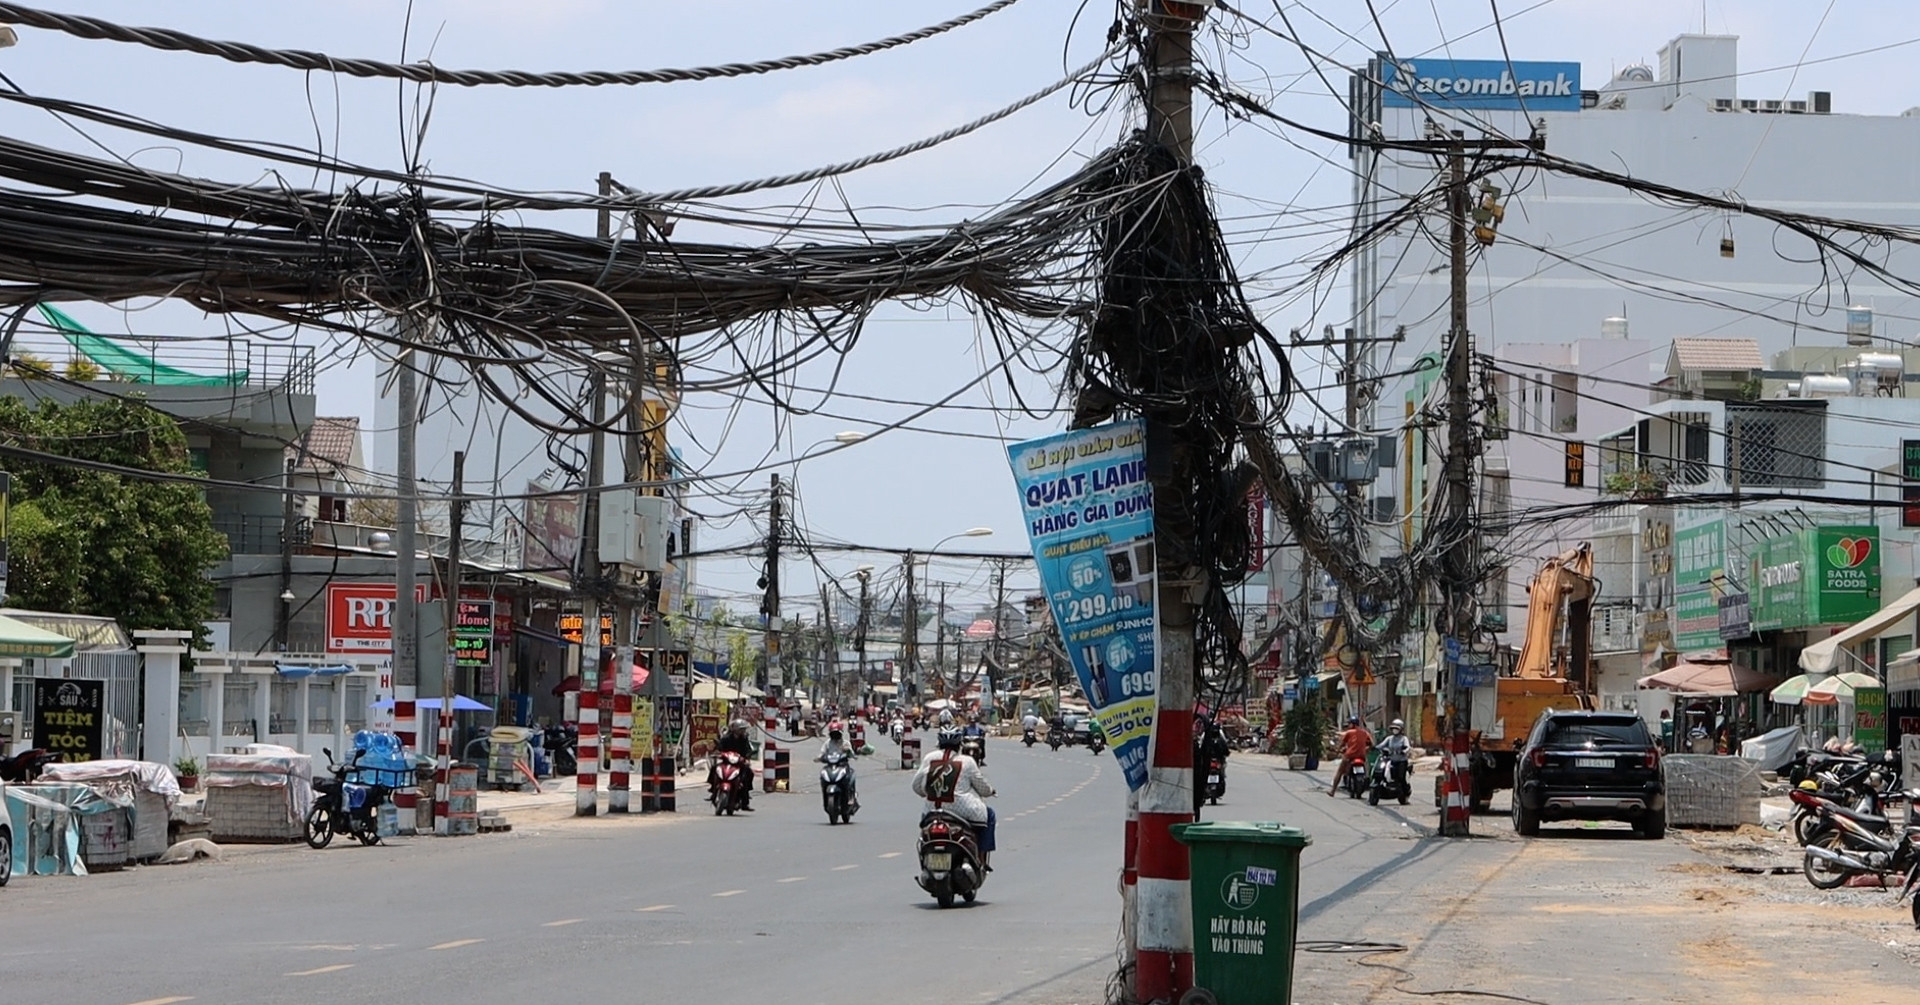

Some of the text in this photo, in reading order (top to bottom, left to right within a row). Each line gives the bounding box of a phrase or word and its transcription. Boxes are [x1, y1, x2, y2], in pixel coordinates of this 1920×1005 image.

[1392, 62, 1573, 96] Sacombank
[1027, 473, 1085, 507] QUẠT
[1033, 512, 1077, 536] HÀNG
[1084, 505, 1108, 523] GIA
[1827, 570, 1866, 578] SATRA
[1827, 579, 1867, 588] FOODS
[44, 709, 93, 731] TIỆM
[49, 731, 87, 748] TÓC
[1211, 915, 1266, 936] HÃY BỎ RÁC
[1212, 934, 1264, 955] VÀO THÙNG
